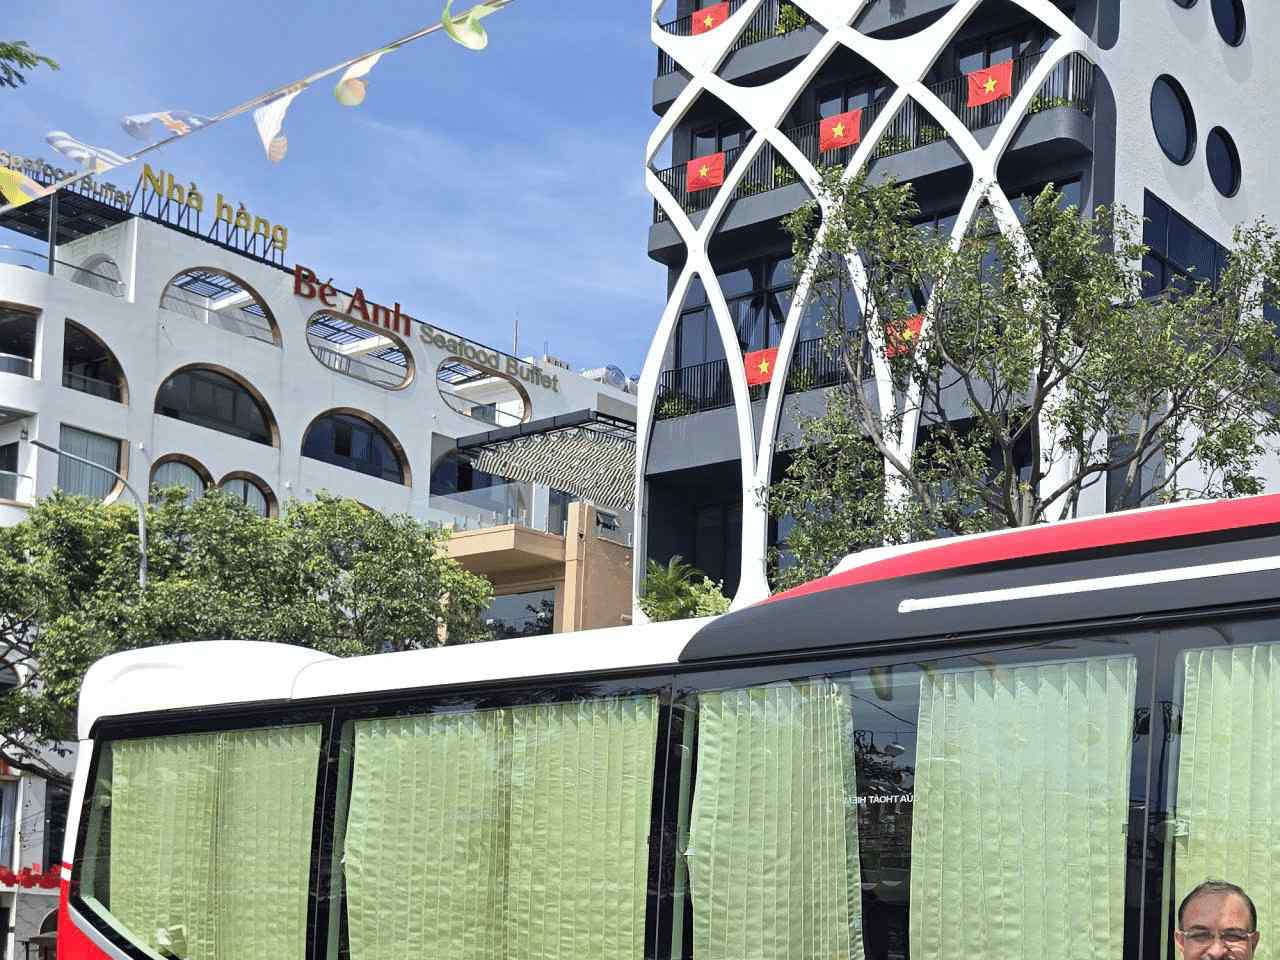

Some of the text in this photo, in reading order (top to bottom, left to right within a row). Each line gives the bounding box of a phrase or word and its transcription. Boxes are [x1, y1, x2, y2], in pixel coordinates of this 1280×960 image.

[142, 163, 289, 251] Nhà hàng
[293, 264, 412, 337] Bé Anh
[419, 324, 560, 393] Seafood Buffet
